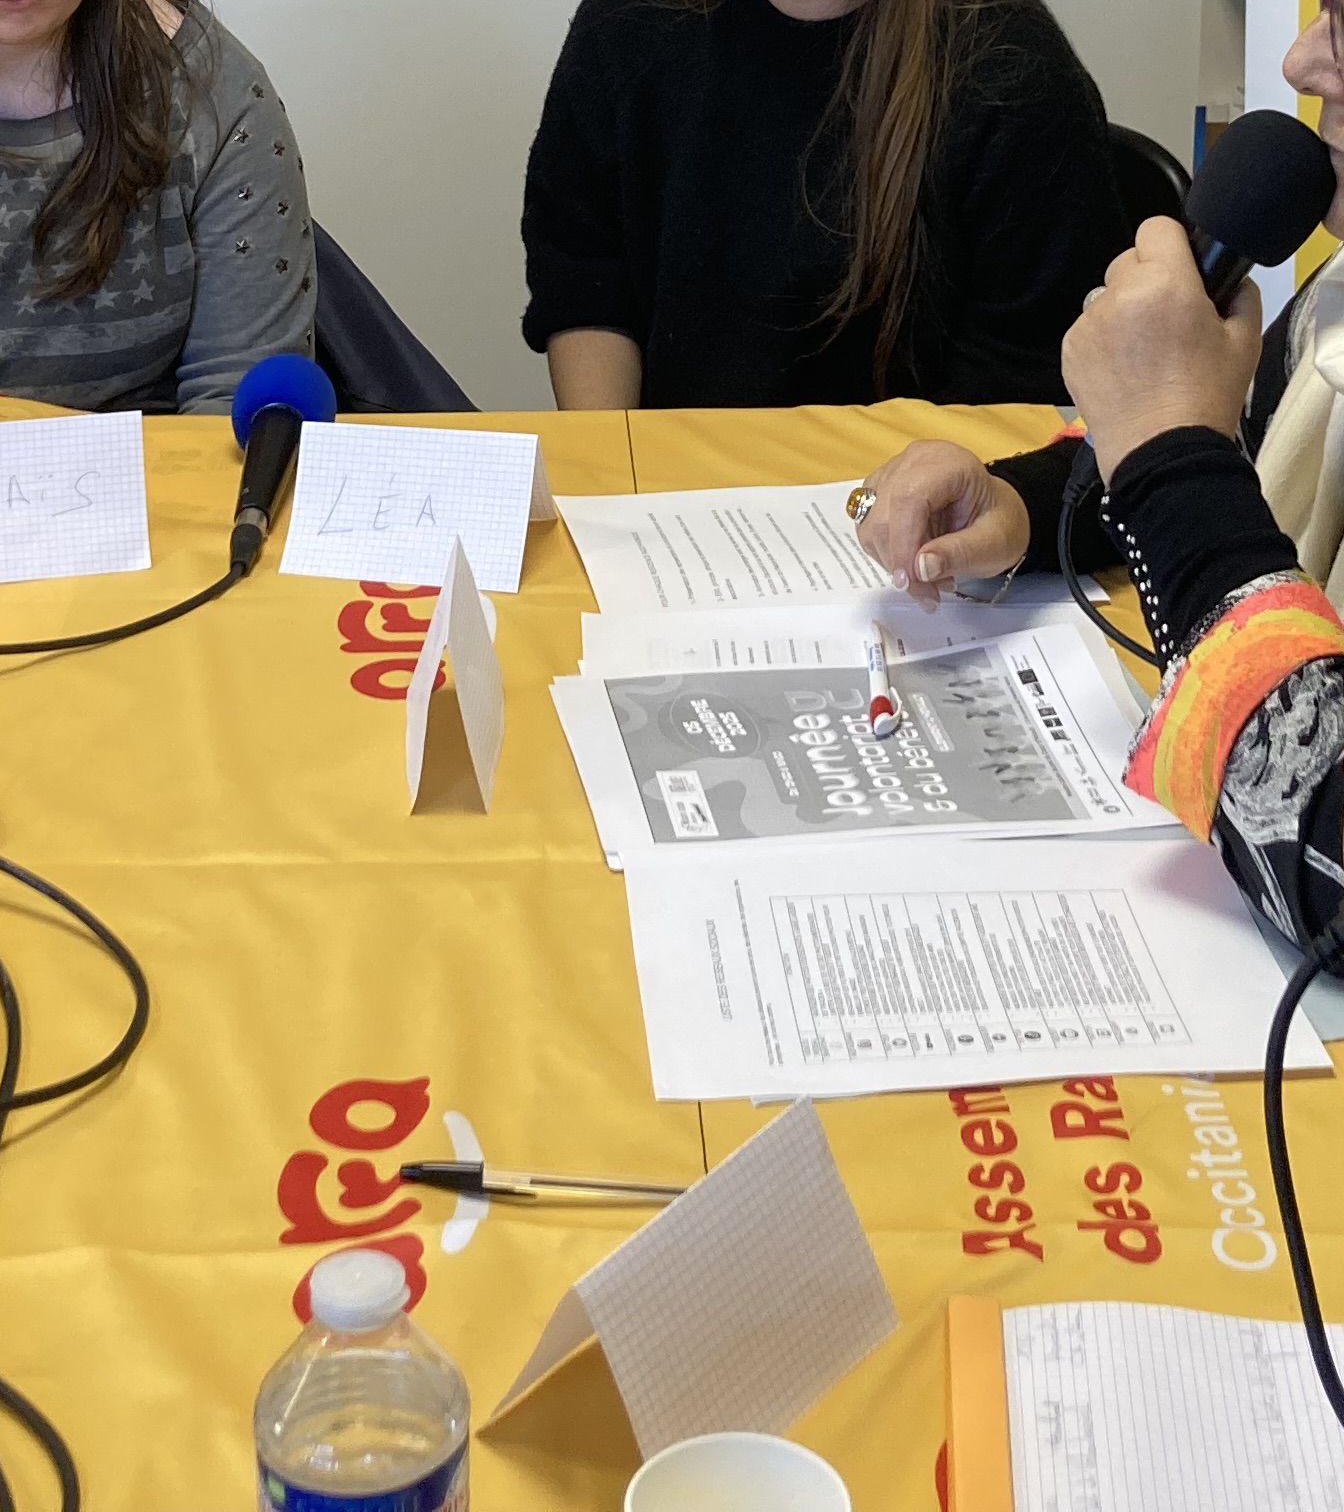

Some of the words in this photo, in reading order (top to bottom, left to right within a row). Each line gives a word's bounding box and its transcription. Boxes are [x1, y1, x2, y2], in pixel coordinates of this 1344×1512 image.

[317, 473, 436, 537] LÉA
[789, 713, 874, 816] Journée
[913, 771, 949, 795] du
[1077, 1162, 1163, 1265] des
